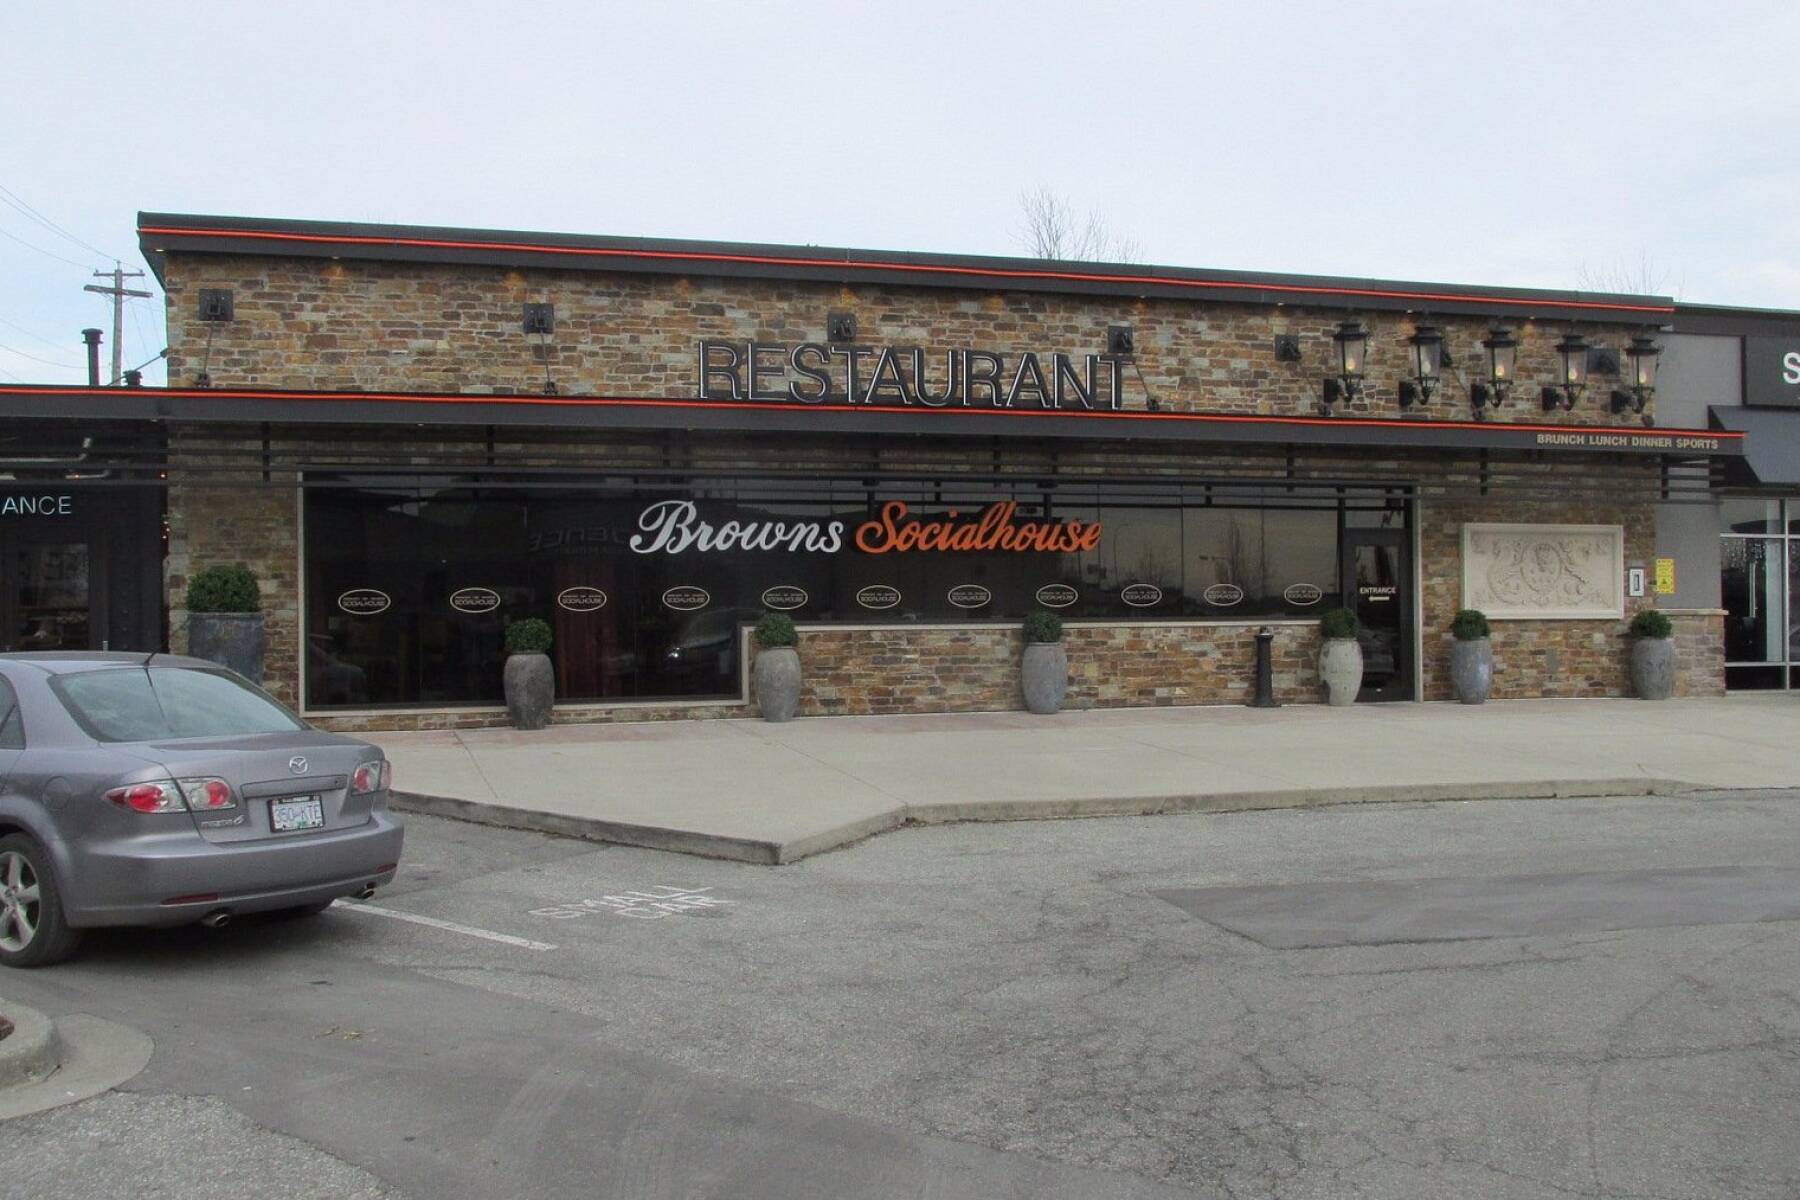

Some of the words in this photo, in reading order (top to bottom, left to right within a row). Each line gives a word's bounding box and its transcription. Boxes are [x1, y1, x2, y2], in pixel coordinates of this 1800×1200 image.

[699, 340, 1133, 411] RESTAURANT
[1536, 434, 1585, 445] BRUNCH
[1589, 436, 1628, 446] LUNCH
[1632, 437, 1673, 448] DINNER
[1676, 438, 1719, 449] SPORTS
[1, 496, 72, 515] ANCE
[629, 500, 843, 554] Browns
[856, 501, 1101, 554] Socialhouse
[1360, 586, 1396, 595] ENTRANCE
